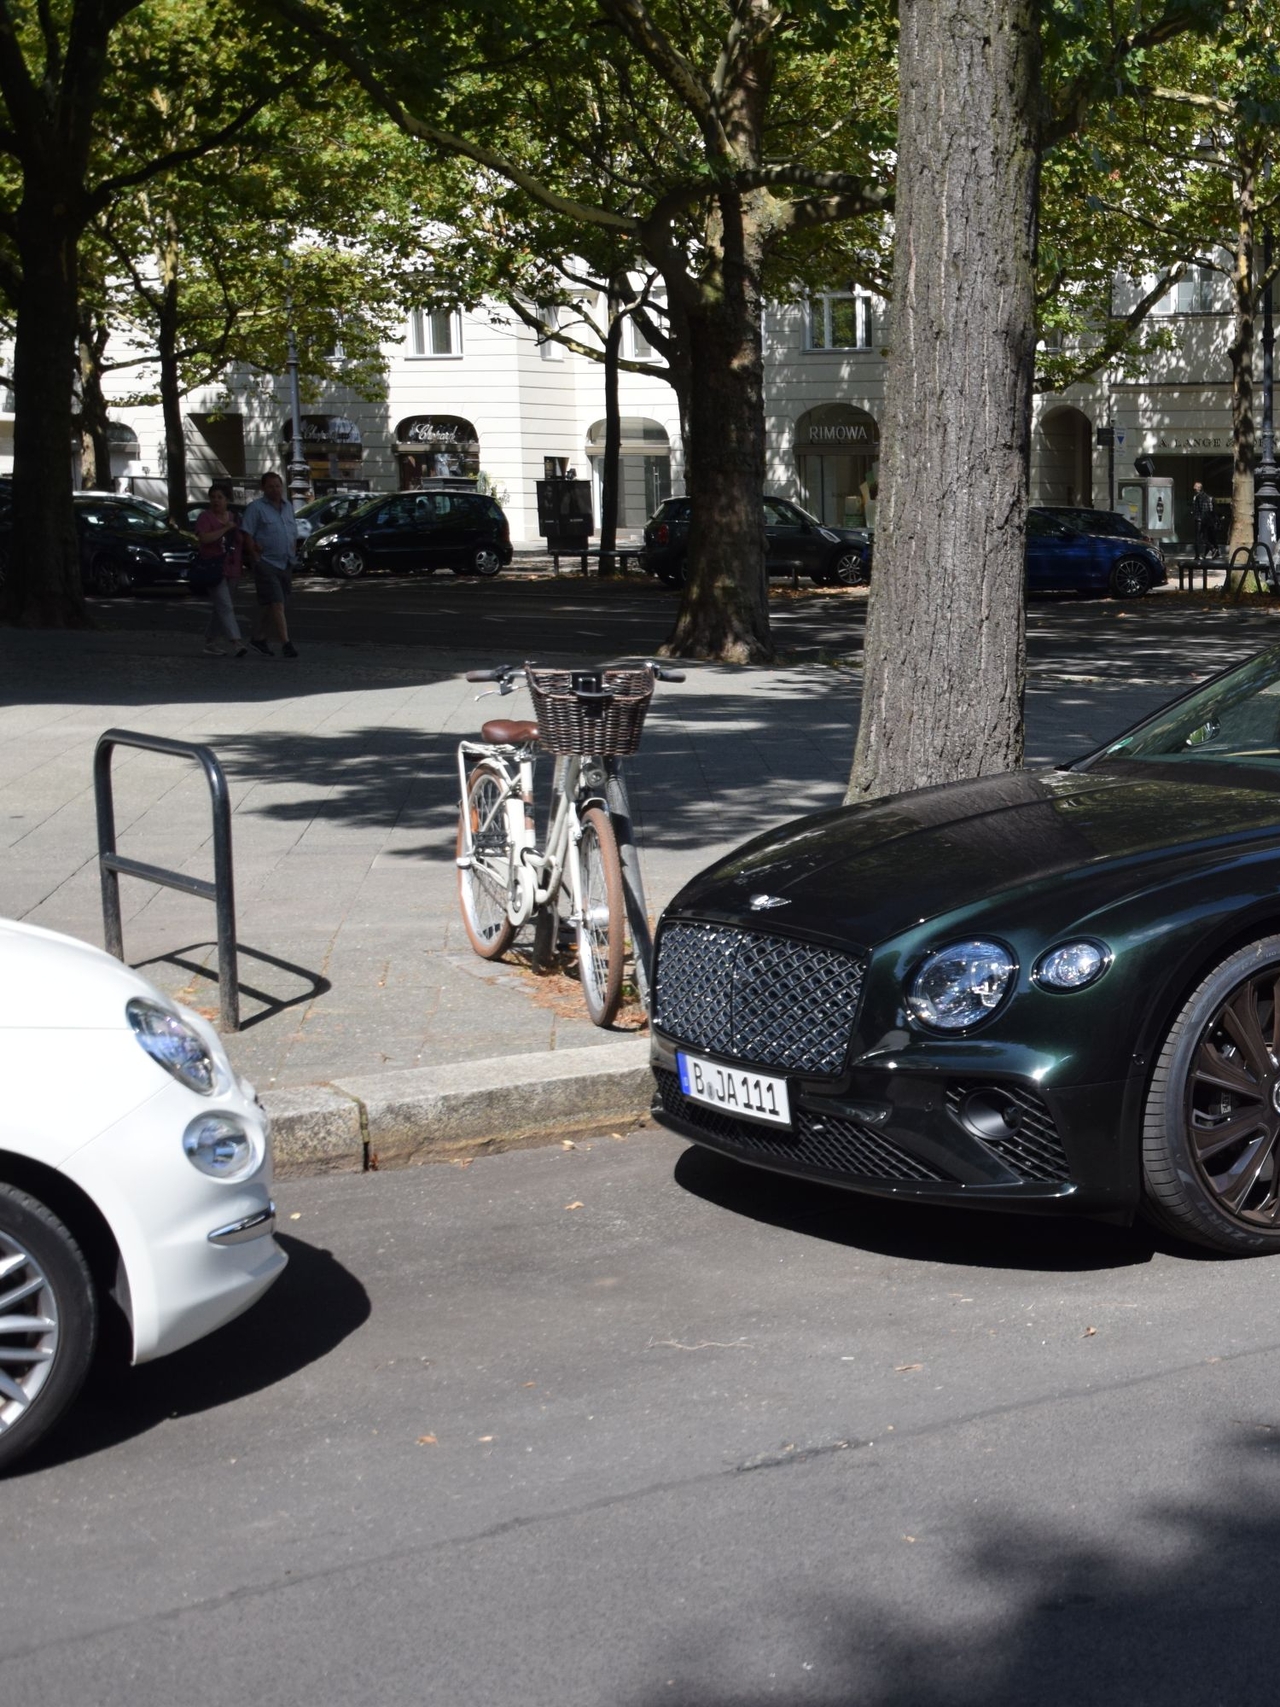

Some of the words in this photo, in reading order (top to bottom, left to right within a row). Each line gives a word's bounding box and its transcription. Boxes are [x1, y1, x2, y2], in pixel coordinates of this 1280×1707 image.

[416, 424, 458, 444] Chopard
[809, 426, 867, 439] RIMOWA
[1175, 438, 1221, 448] LANGE
